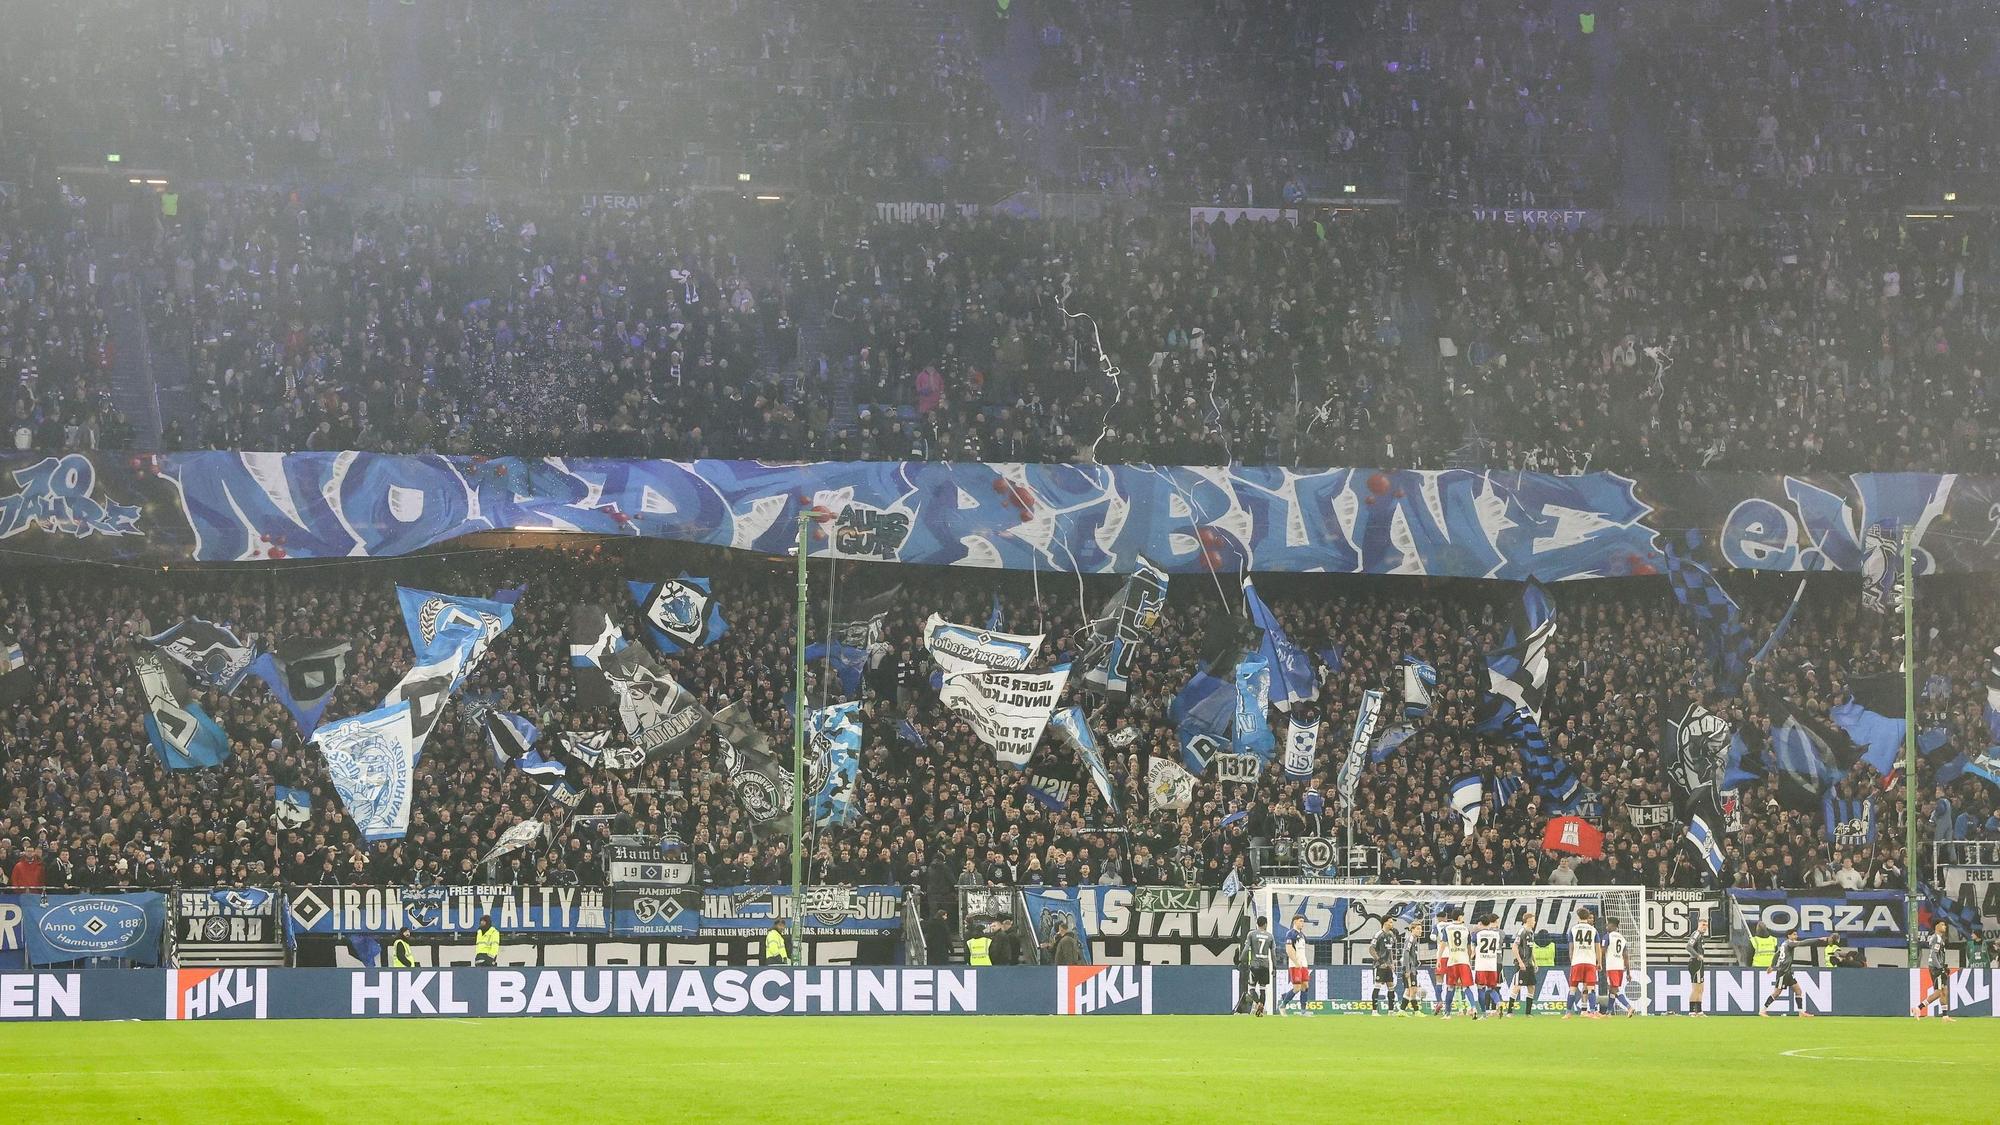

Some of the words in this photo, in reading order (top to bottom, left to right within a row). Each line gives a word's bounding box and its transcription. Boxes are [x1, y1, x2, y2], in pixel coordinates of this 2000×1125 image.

[1219, 755, 1257, 776] 1312
[616, 847, 689, 864] Hambg
[1310, 845, 1328, 862] 12
[1966, 871, 1993, 881] FREE
[450, 886, 475, 896] FREE
[639, 887, 682, 896] HAMBURG
[1654, 890, 1703, 901] HAMBURG
[69, 901, 119, 916] Fanclub
[332, 888, 402, 931] IRON
[856, 892, 896, 920] SÜD
[1732, 904, 1901, 932] FORZA
[44, 922, 76, 932] Anno
[633, 925, 683, 933] HOOLIGANS
[699, 927, 717, 936] EHRE
[717, 927, 737, 937] ALLEN
[818, 928, 834, 937] FANS
[57, 932, 119, 949] Hamburger
[1259, 938, 1266, 954] 7
[1453, 930, 1462, 947] 8
[1480, 937, 1497, 954] 24
[1575, 929, 1592, 946] 44
[1616, 938, 1622, 954] 6
[183, 969, 254, 1019] HKL
[351, 972, 468, 1014] HKL
[488, 969, 977, 1014] BAUMASCHINEN
[1075, 966, 1139, 1014] HKL
[1332, 1000, 1374, 1011] bet365
